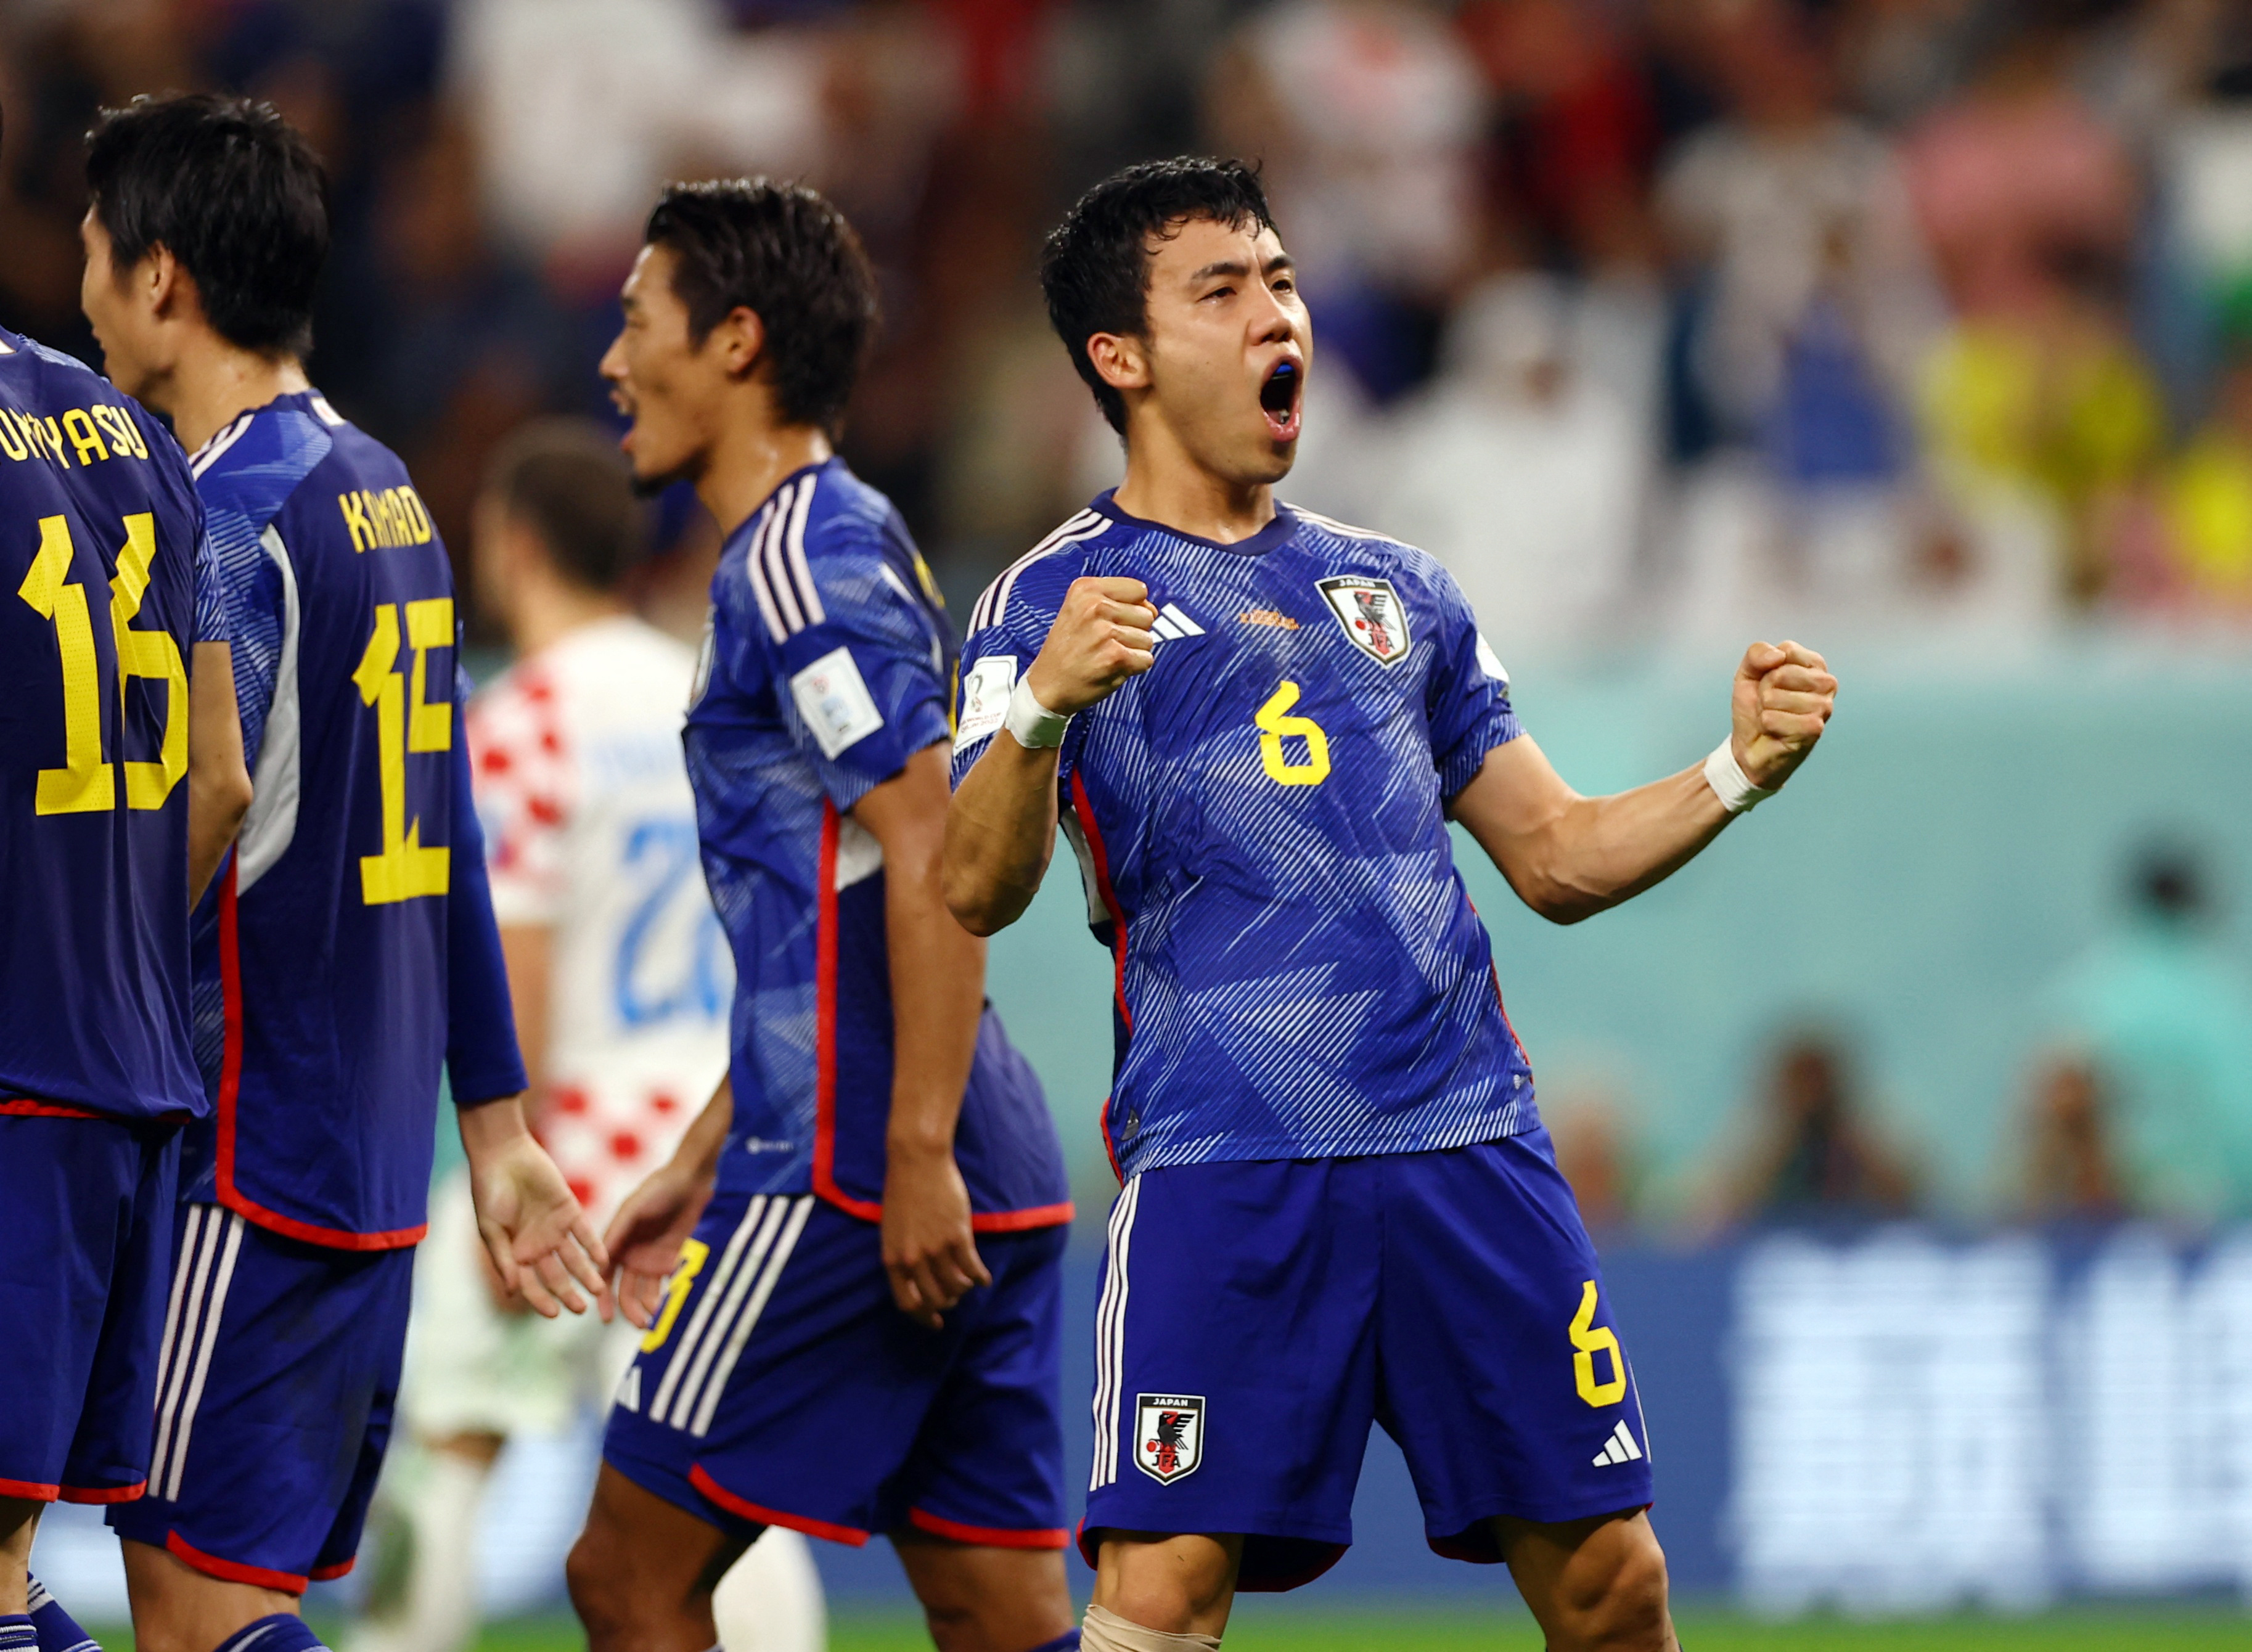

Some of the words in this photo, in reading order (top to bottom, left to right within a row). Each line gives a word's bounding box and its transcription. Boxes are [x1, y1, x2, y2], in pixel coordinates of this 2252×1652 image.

[1339, 579, 1376, 587] JAPAN
[18, 512, 189, 816] 16
[351, 598, 454, 906] 15
[1255, 680, 1331, 786] 6
[1568, 1280, 1626, 1408] 6
[1152, 1397, 1189, 1407] JAPAN
[1152, 1454, 1181, 1468] JFA
